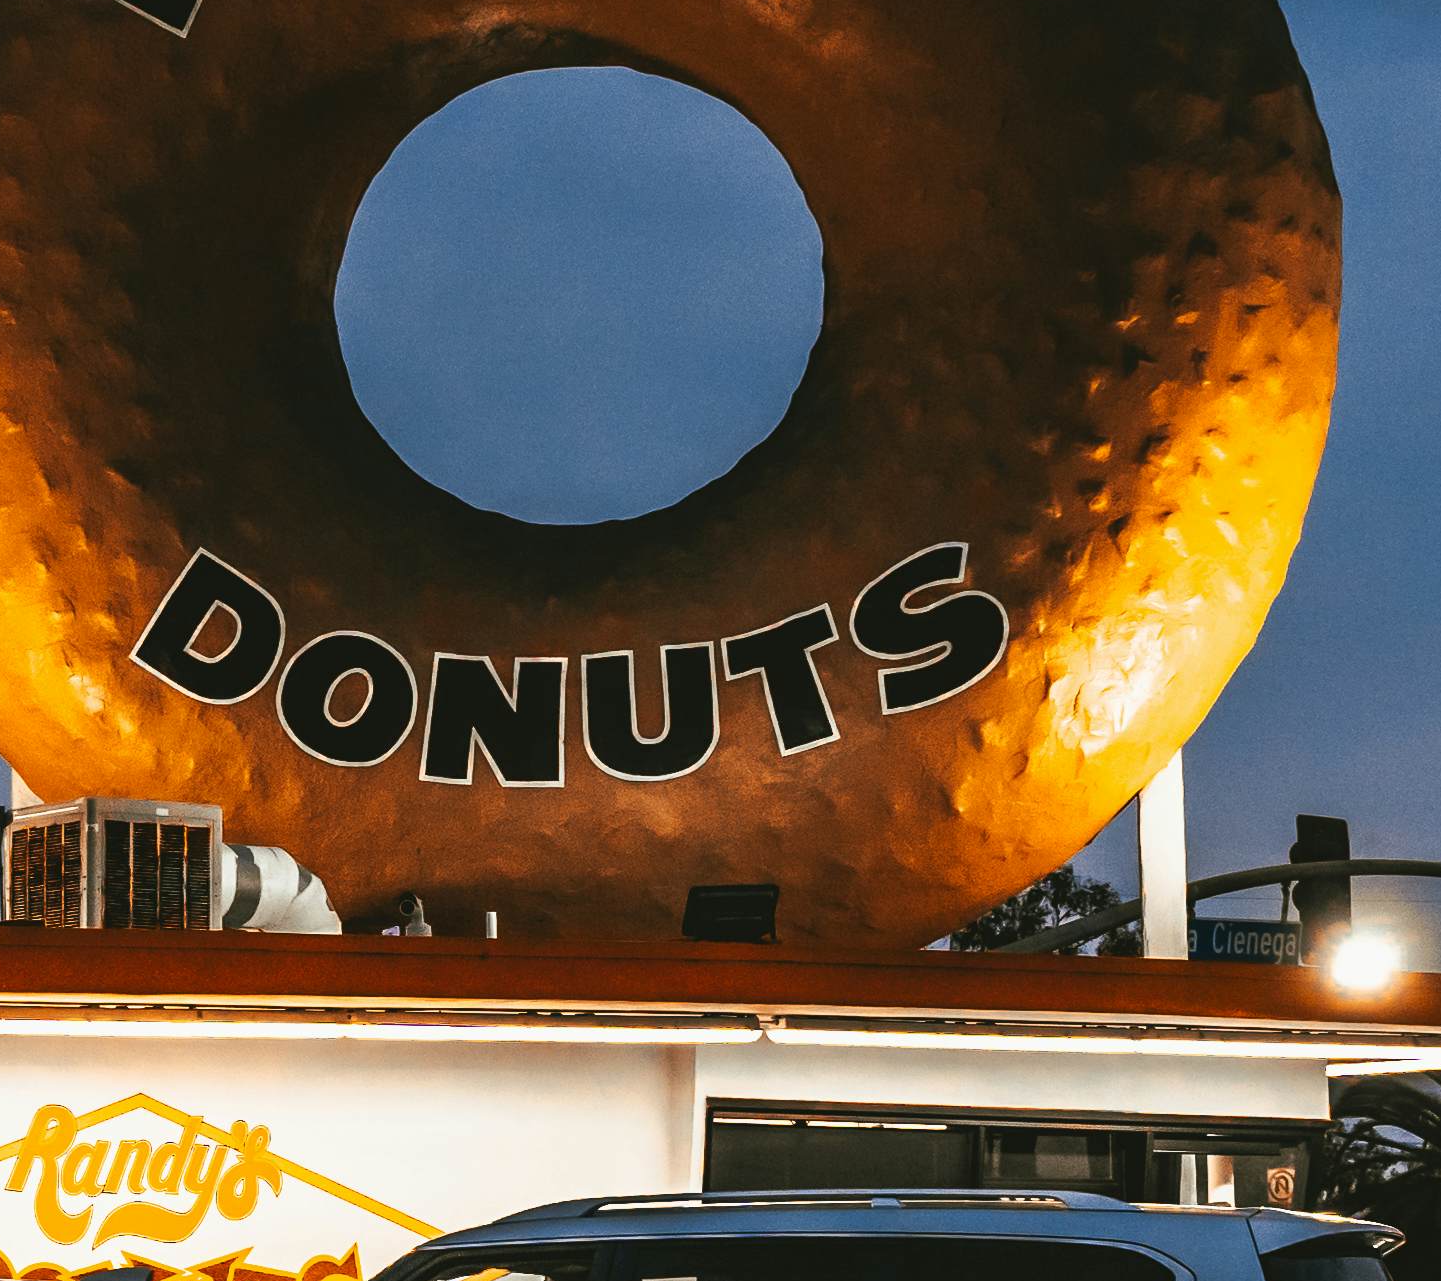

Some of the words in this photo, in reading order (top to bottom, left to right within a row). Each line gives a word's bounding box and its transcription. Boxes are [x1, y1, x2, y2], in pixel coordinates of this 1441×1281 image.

[130, 542, 1008, 787] DONUTS
[1212, 922, 1297, 964] Cienega
[4, 1104, 283, 1248] Randy's
